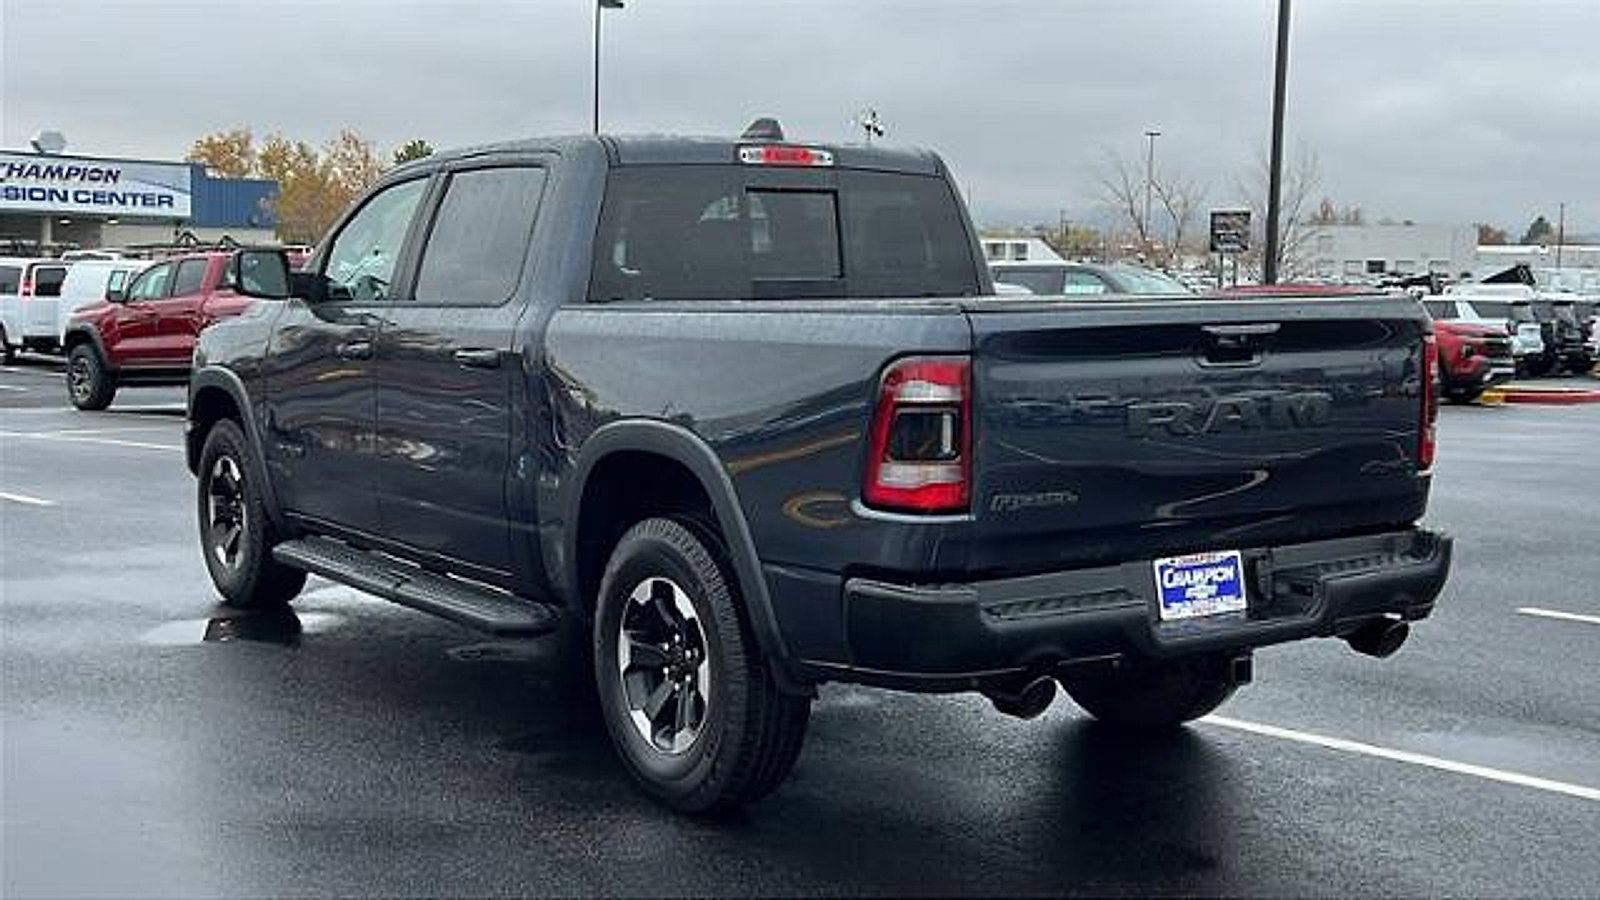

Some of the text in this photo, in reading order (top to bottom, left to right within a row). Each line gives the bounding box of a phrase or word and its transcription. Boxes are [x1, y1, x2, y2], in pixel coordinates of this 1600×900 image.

[74, 189, 174, 208] CENTER
[1127, 390, 1333, 438] RAM
[1163, 565, 1235, 588] CHAMPION
